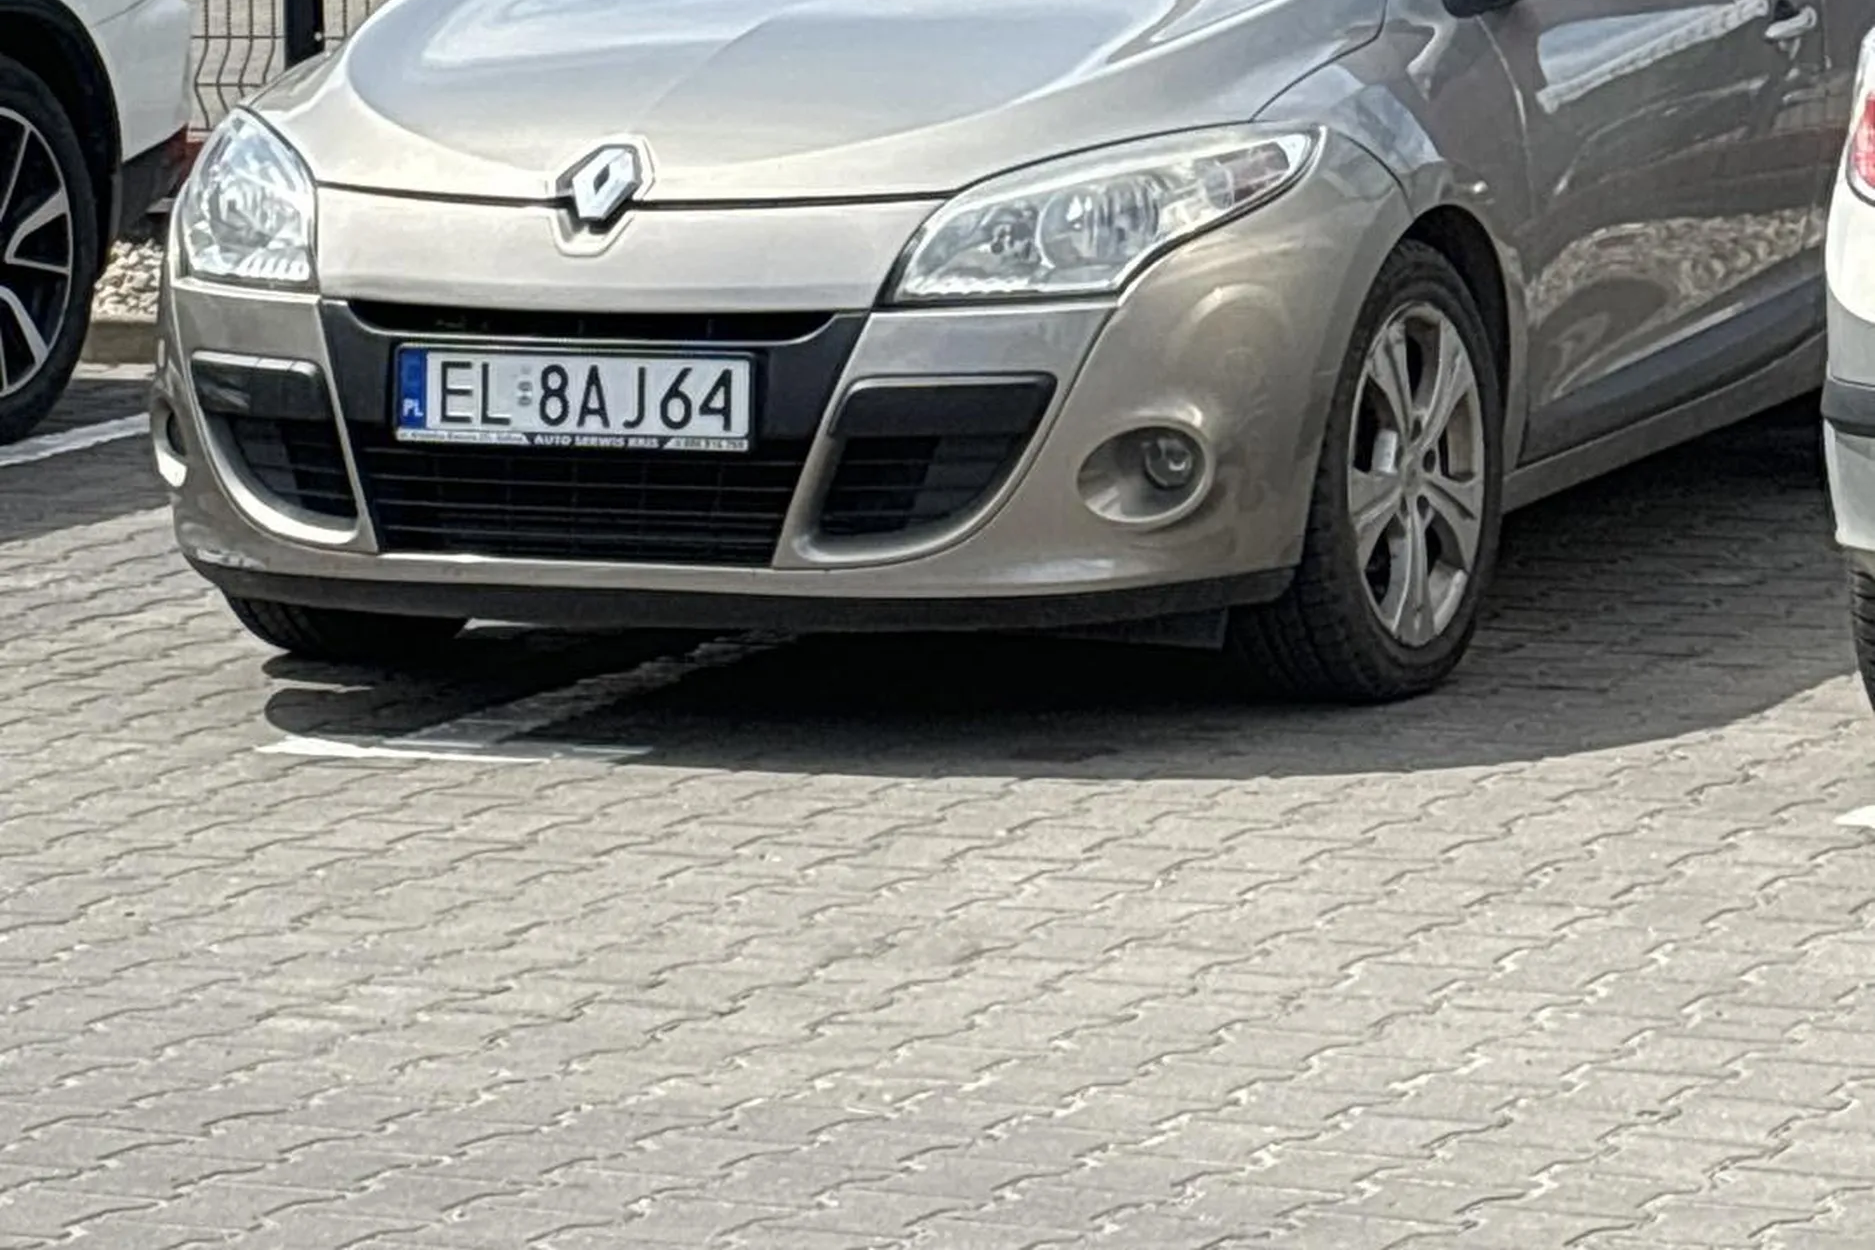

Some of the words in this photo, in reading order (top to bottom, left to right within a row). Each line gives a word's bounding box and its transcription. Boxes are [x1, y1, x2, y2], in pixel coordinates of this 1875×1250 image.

[440, 360, 511, 426] EL
[539, 363, 732, 432] 8AJ64
[402, 398, 423, 417] PL
[533, 434, 573, 447] AUTO
